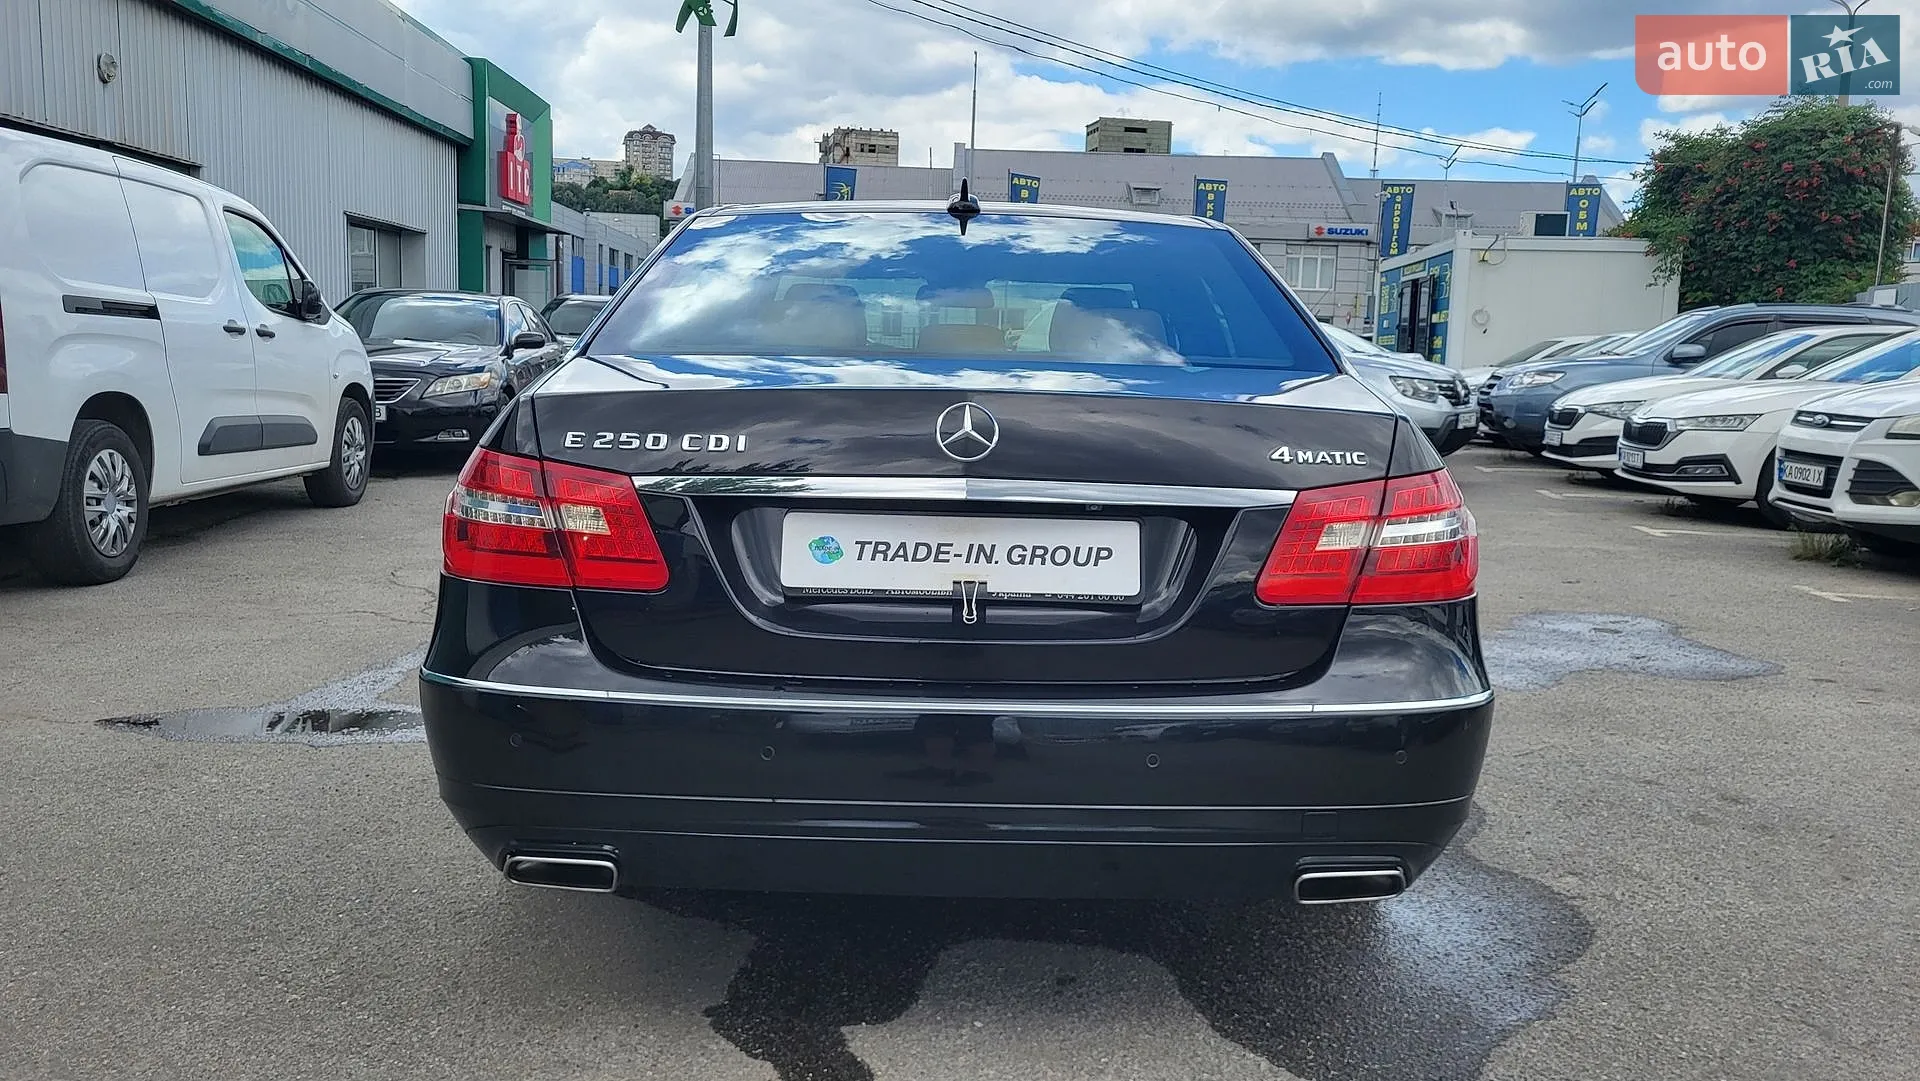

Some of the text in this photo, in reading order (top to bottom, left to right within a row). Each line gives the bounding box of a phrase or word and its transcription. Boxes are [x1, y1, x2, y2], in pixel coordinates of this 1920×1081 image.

[1012, 177, 1039, 188] АВТО
[1198, 183, 1226, 191] АВТО
[1386, 186, 1413, 194] АВТО
[1569, 188, 1601, 196] АВТО
[1327, 227, 1369, 236] SUZUKI
[564, 431, 747, 452] E 250 CDI
[1006, 543, 1113, 567] GROUP
